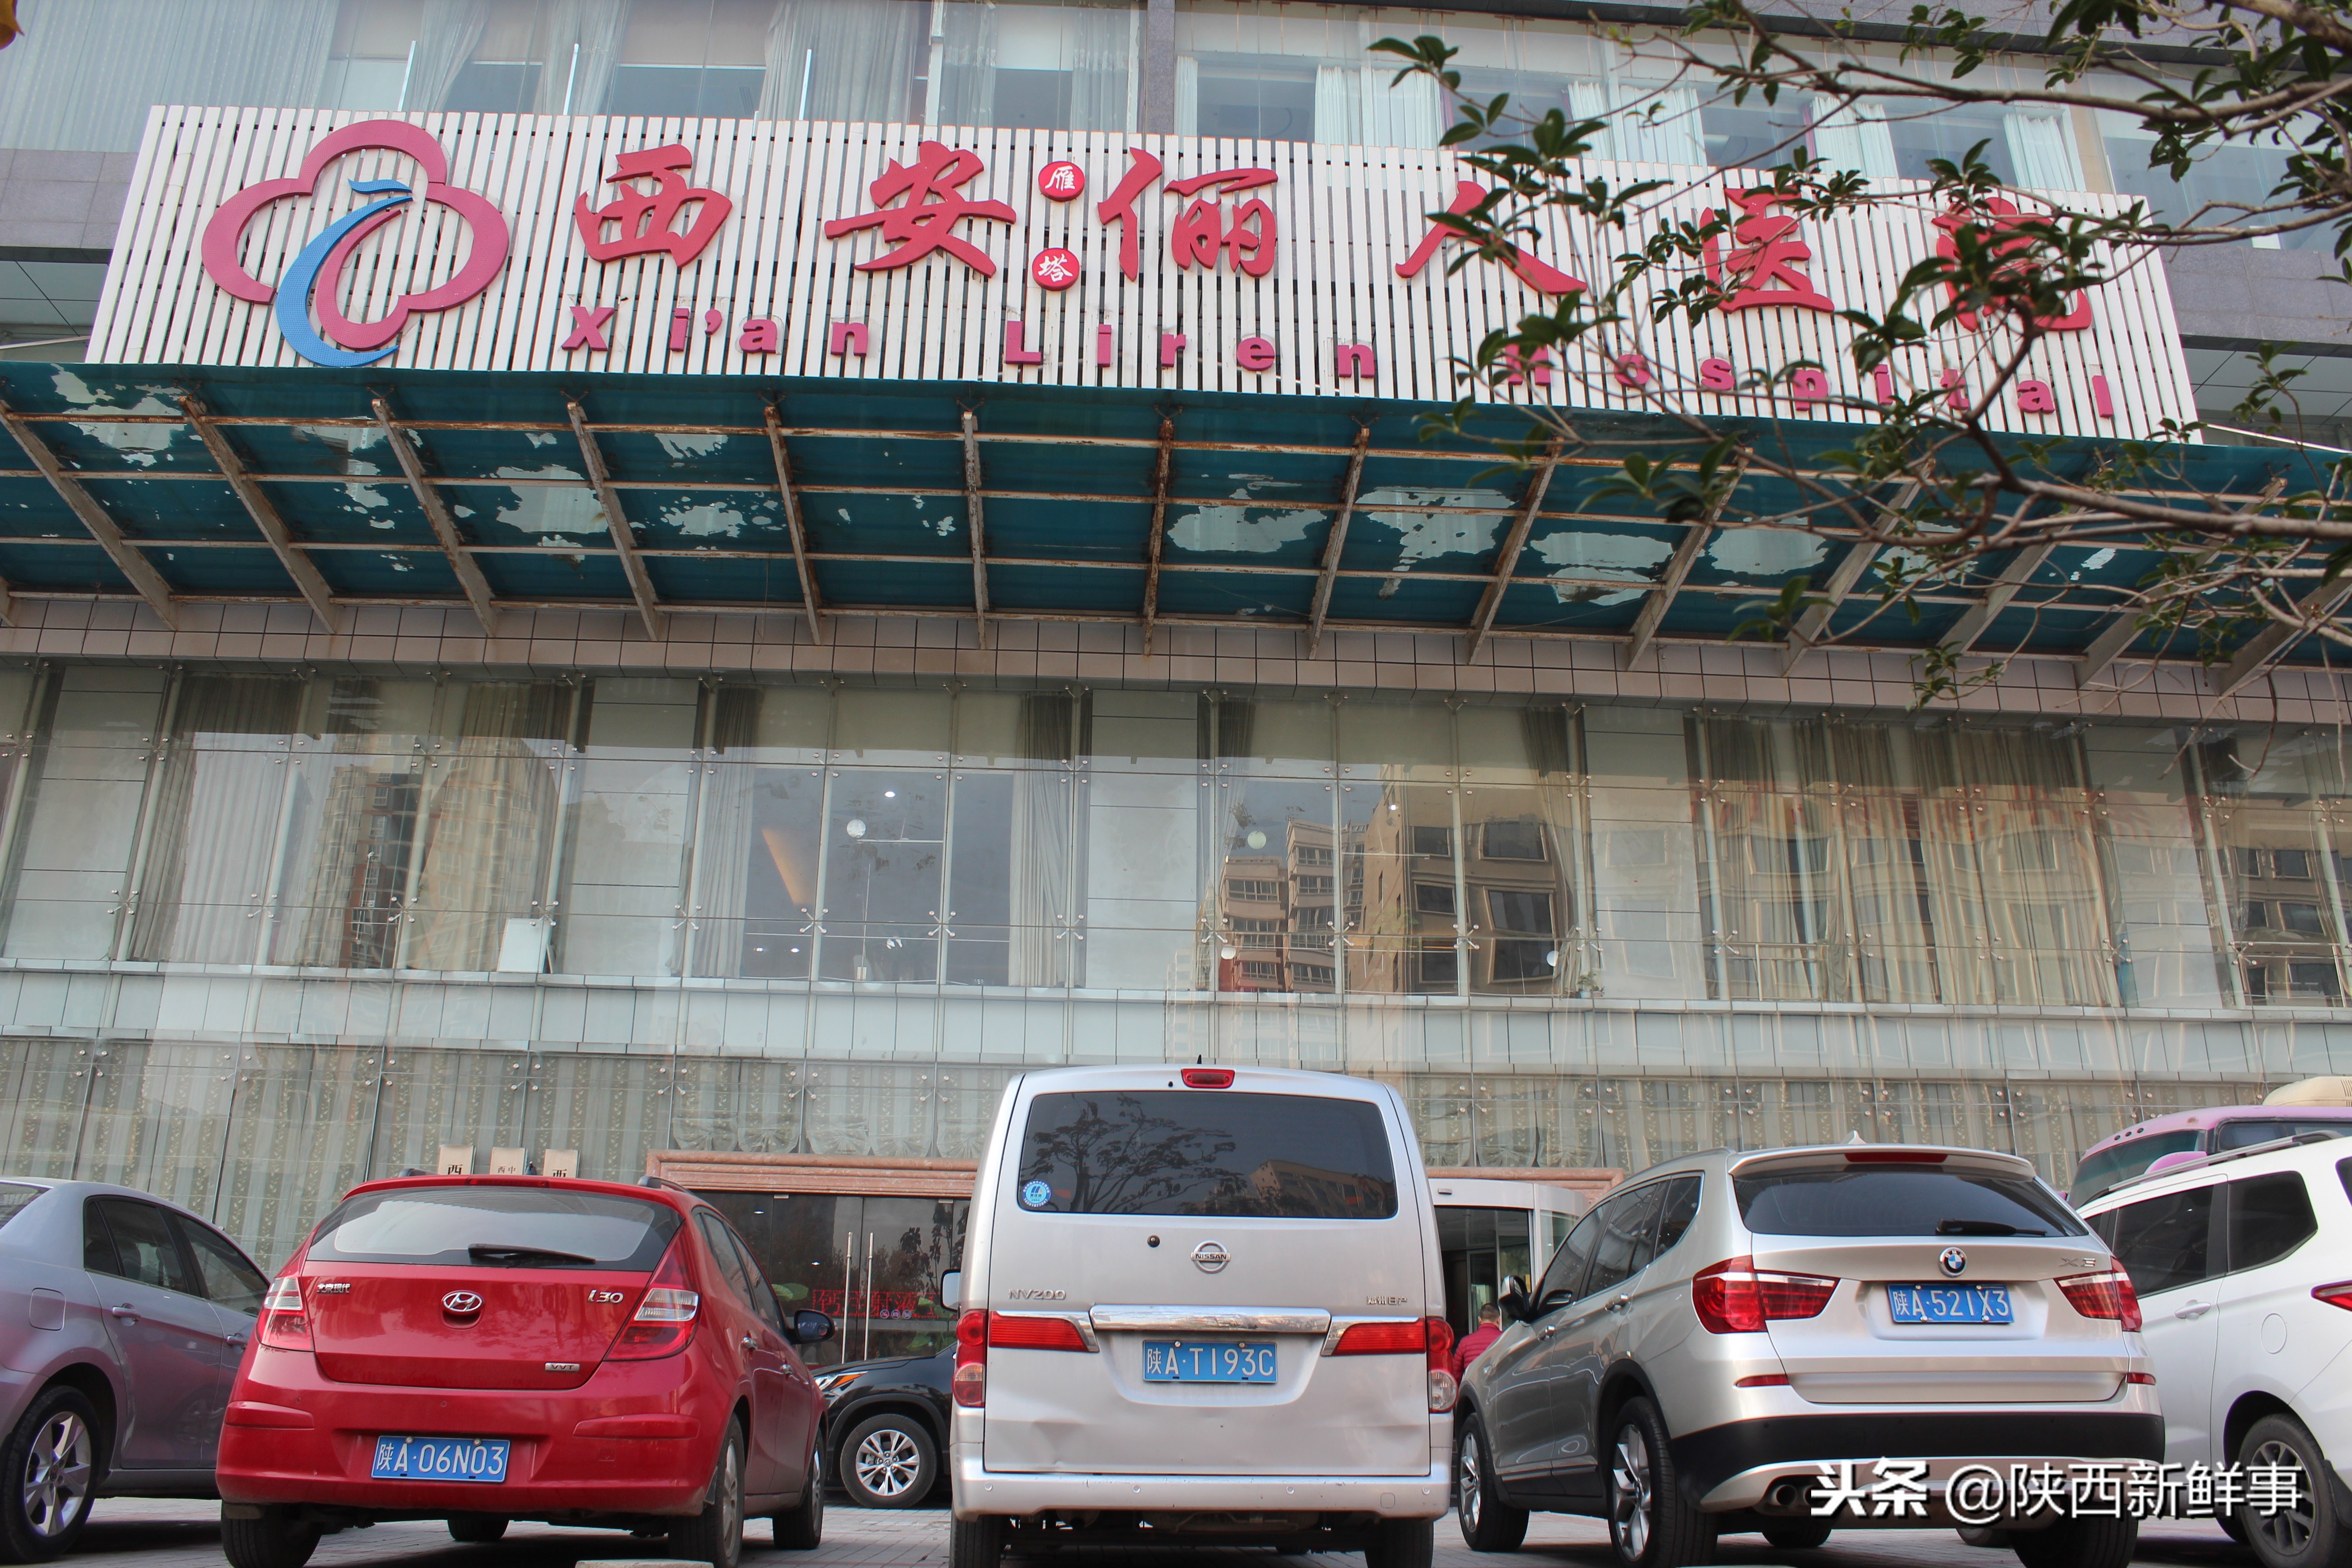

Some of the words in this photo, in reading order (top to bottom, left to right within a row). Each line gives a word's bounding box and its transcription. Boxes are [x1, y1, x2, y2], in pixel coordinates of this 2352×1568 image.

[561, 306, 869, 356] Xi'an
[1004, 321, 1375, 378] Liren
[2058, 1257, 2096, 1267] X3
[1009, 1289, 1066, 1300] NV200
